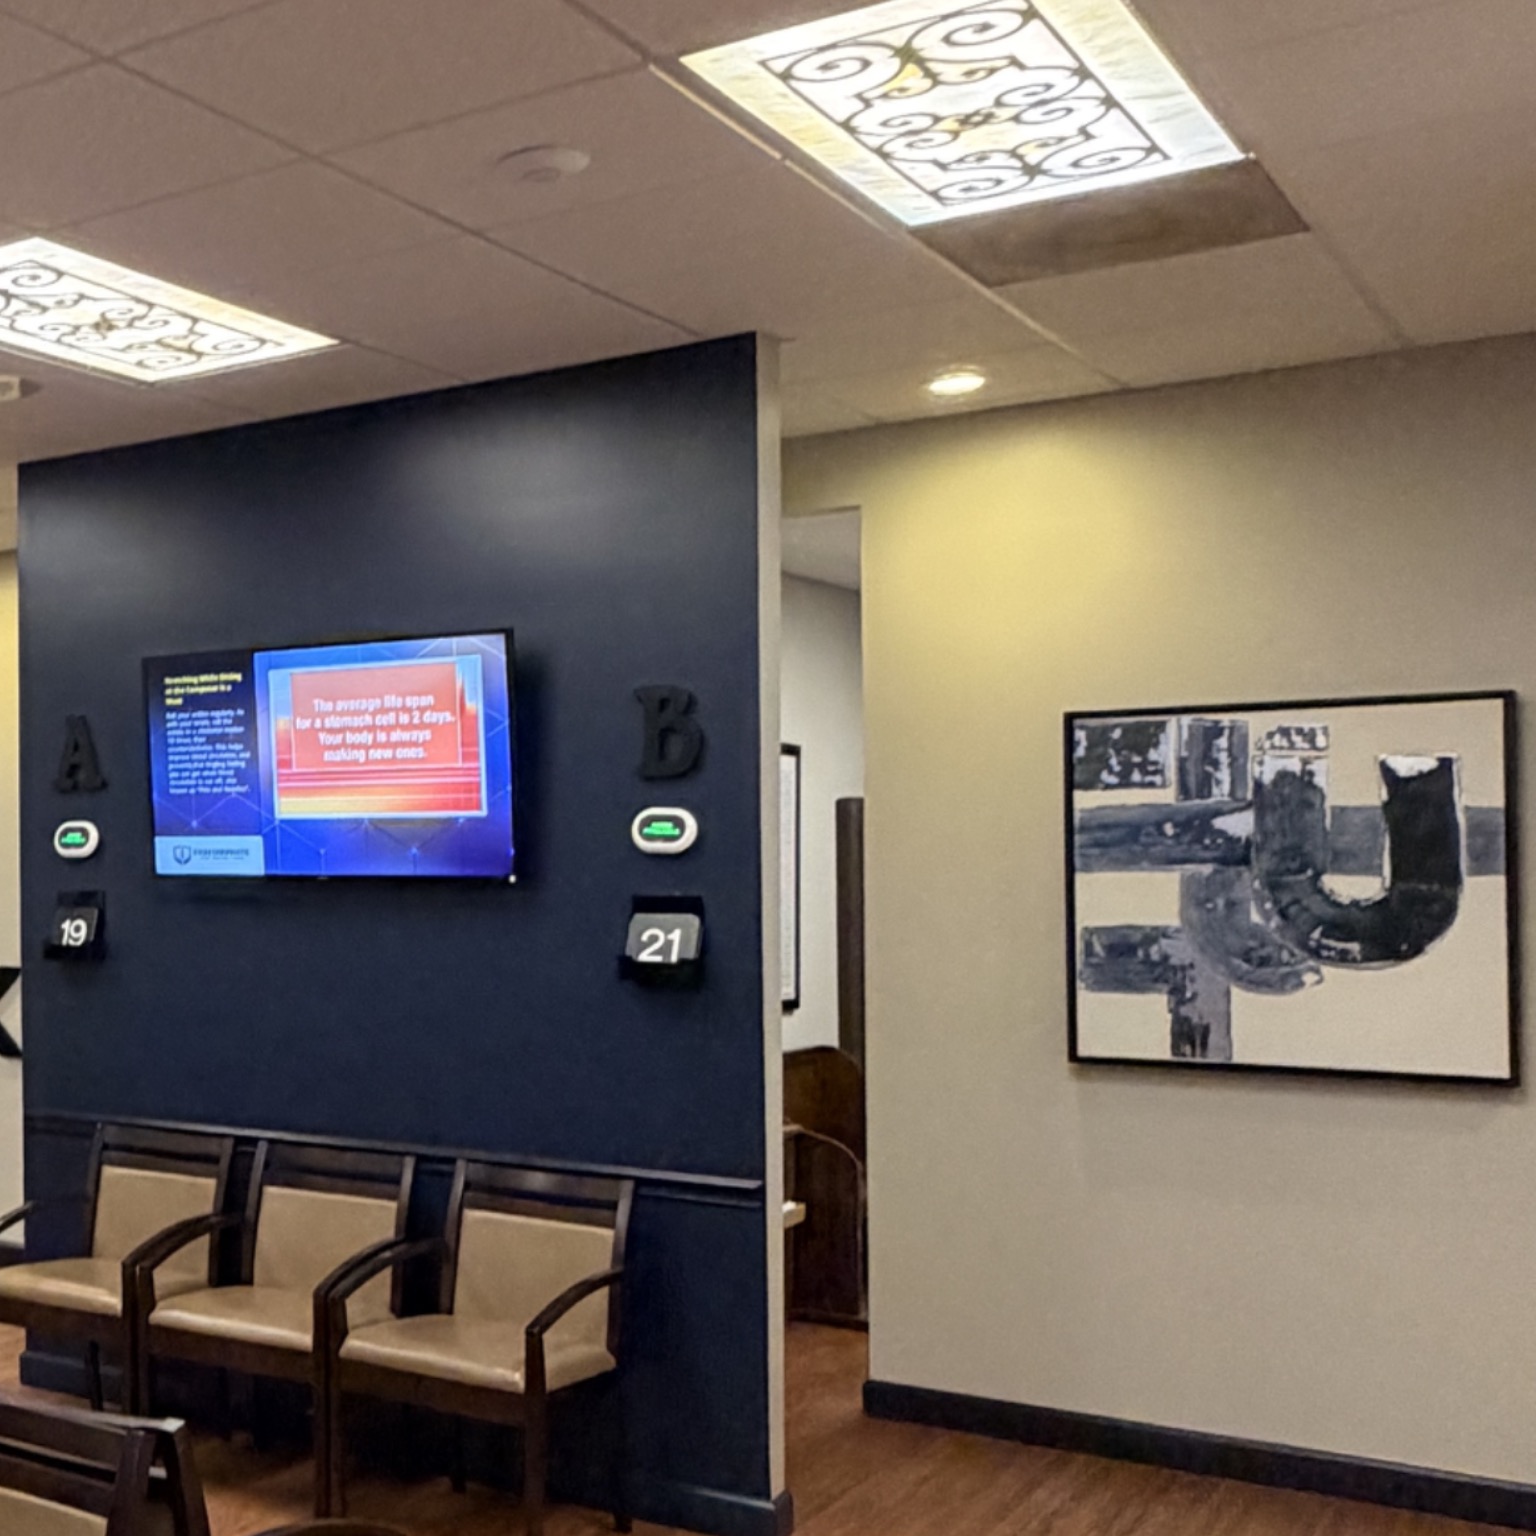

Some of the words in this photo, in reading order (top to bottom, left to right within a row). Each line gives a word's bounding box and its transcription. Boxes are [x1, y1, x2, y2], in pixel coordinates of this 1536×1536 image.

[313, 698, 333, 711] The
[336, 697, 381, 711] average
[384, 694, 402, 708] life
[405, 694, 434, 708] span
[296, 716, 311, 730] for
[314, 717, 321, 728] a
[324, 714, 373, 728] stomach
[375, 712, 396, 726] cell
[399, 711, 409, 725] is
[412, 711, 421, 724] 2
[423, 710, 455, 724] days.
[634, 684, 705, 780] B
[318, 731, 343, 746] Your
[346, 730, 373, 746] body
[377, 729, 386, 743] is
[390, 729, 432, 743] always
[53, 713, 109, 793] A
[323, 748, 366, 763] making
[368, 748, 393, 759] new
[395, 747, 428, 759] ones.
[61, 918, 87, 946] 19
[637, 927, 682, 964] 21
